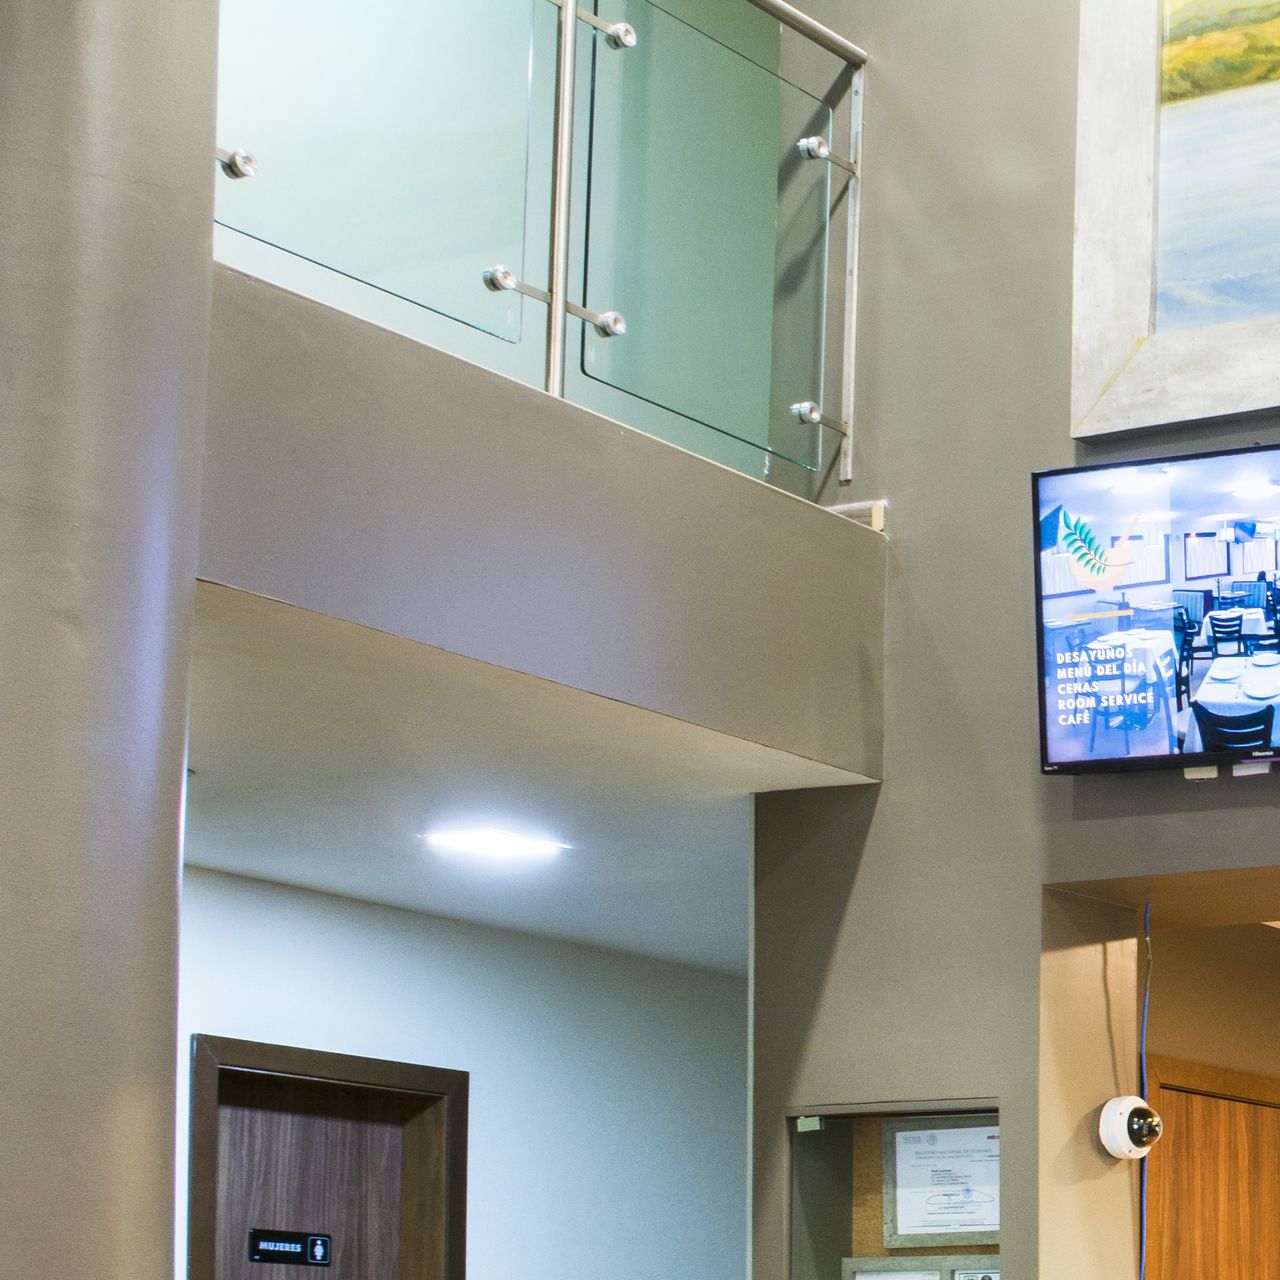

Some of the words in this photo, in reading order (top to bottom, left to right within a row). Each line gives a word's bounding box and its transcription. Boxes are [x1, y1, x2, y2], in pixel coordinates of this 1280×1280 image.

[1056, 647, 1133, 664] DESAYUNOS
[1056, 661, 1092, 679] MENÚ
[1096, 663, 1121, 676] DEL
[1123, 658, 1147, 673] DÍA
[1057, 681, 1100, 695] CENAS
[1058, 696, 1096, 710] ROOM
[1100, 692, 1154, 707] SERVICE
[1058, 710, 1091, 726] CAFÉ
[258, 1241, 302, 1253] MUJERES
